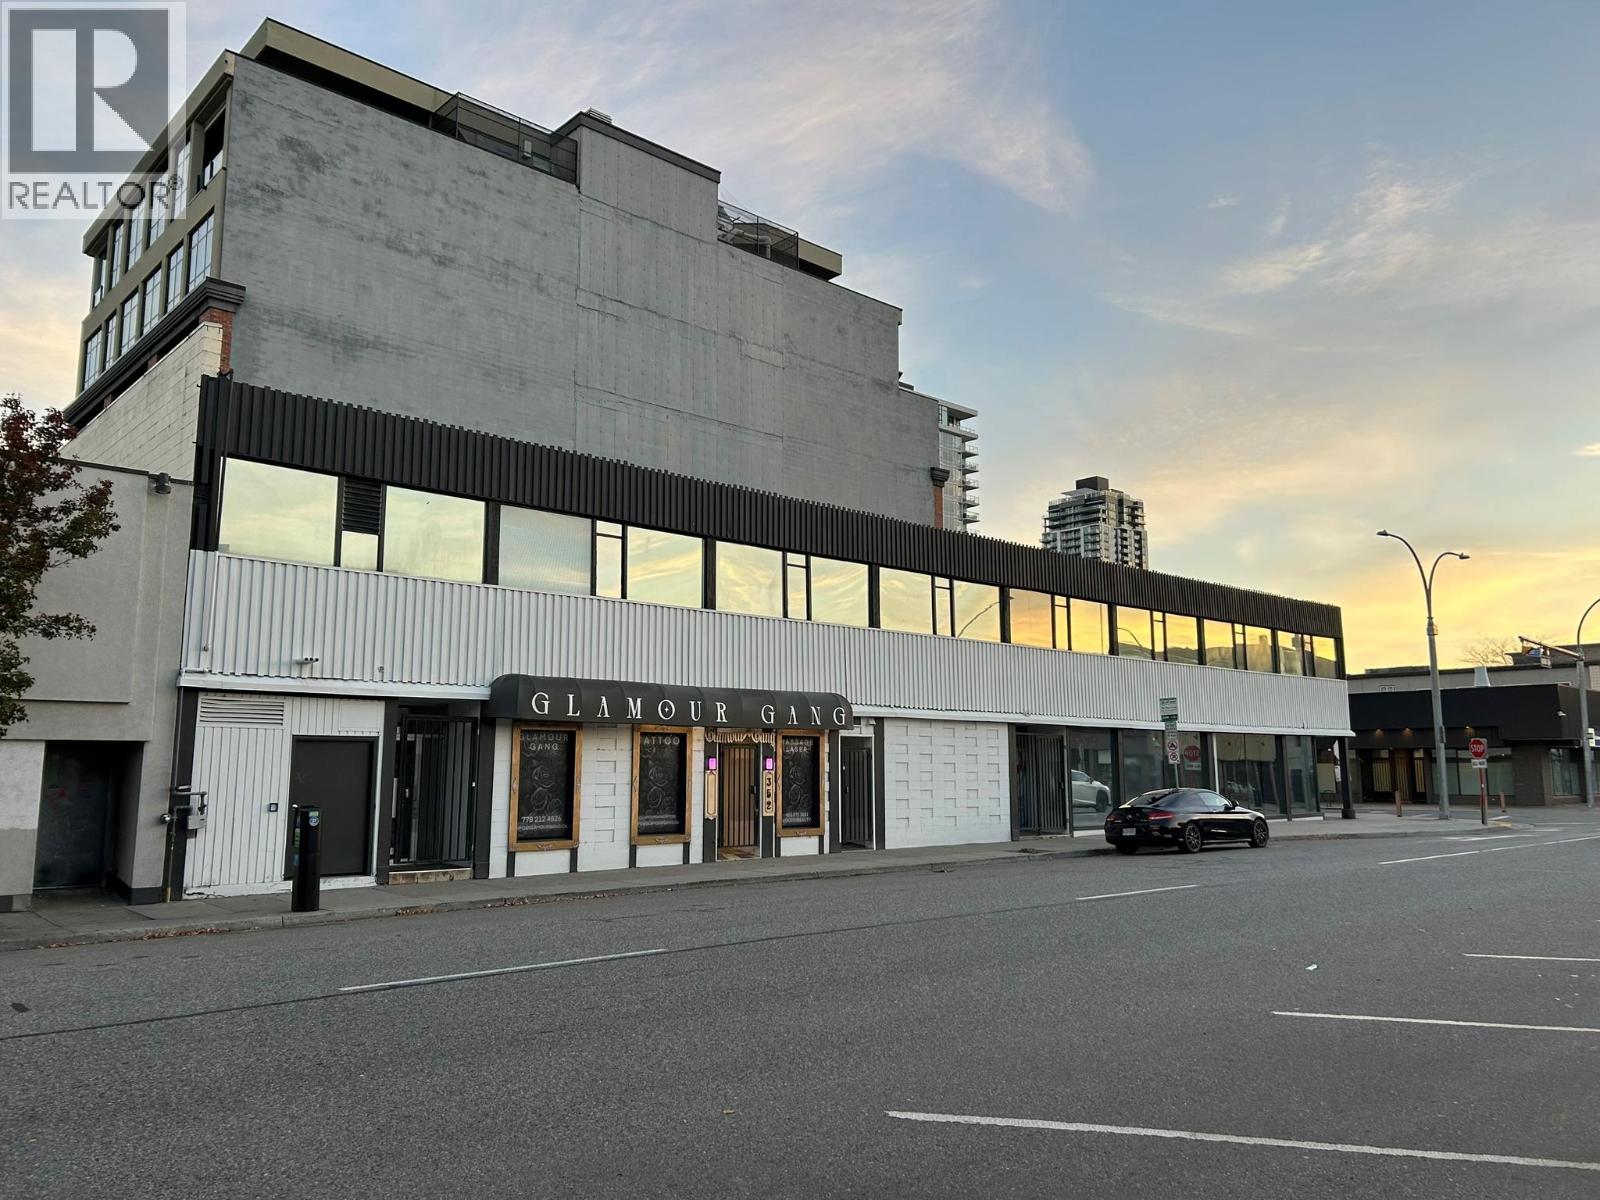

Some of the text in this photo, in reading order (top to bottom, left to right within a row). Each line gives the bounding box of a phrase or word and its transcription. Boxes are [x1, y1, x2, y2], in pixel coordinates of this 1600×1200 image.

[531, 691, 846, 726] GLAMOUR GANG
[640, 735, 680, 746] ATTOO
[529, 742, 560, 751] GANG
[1470, 744, 1485, 753] STOP
